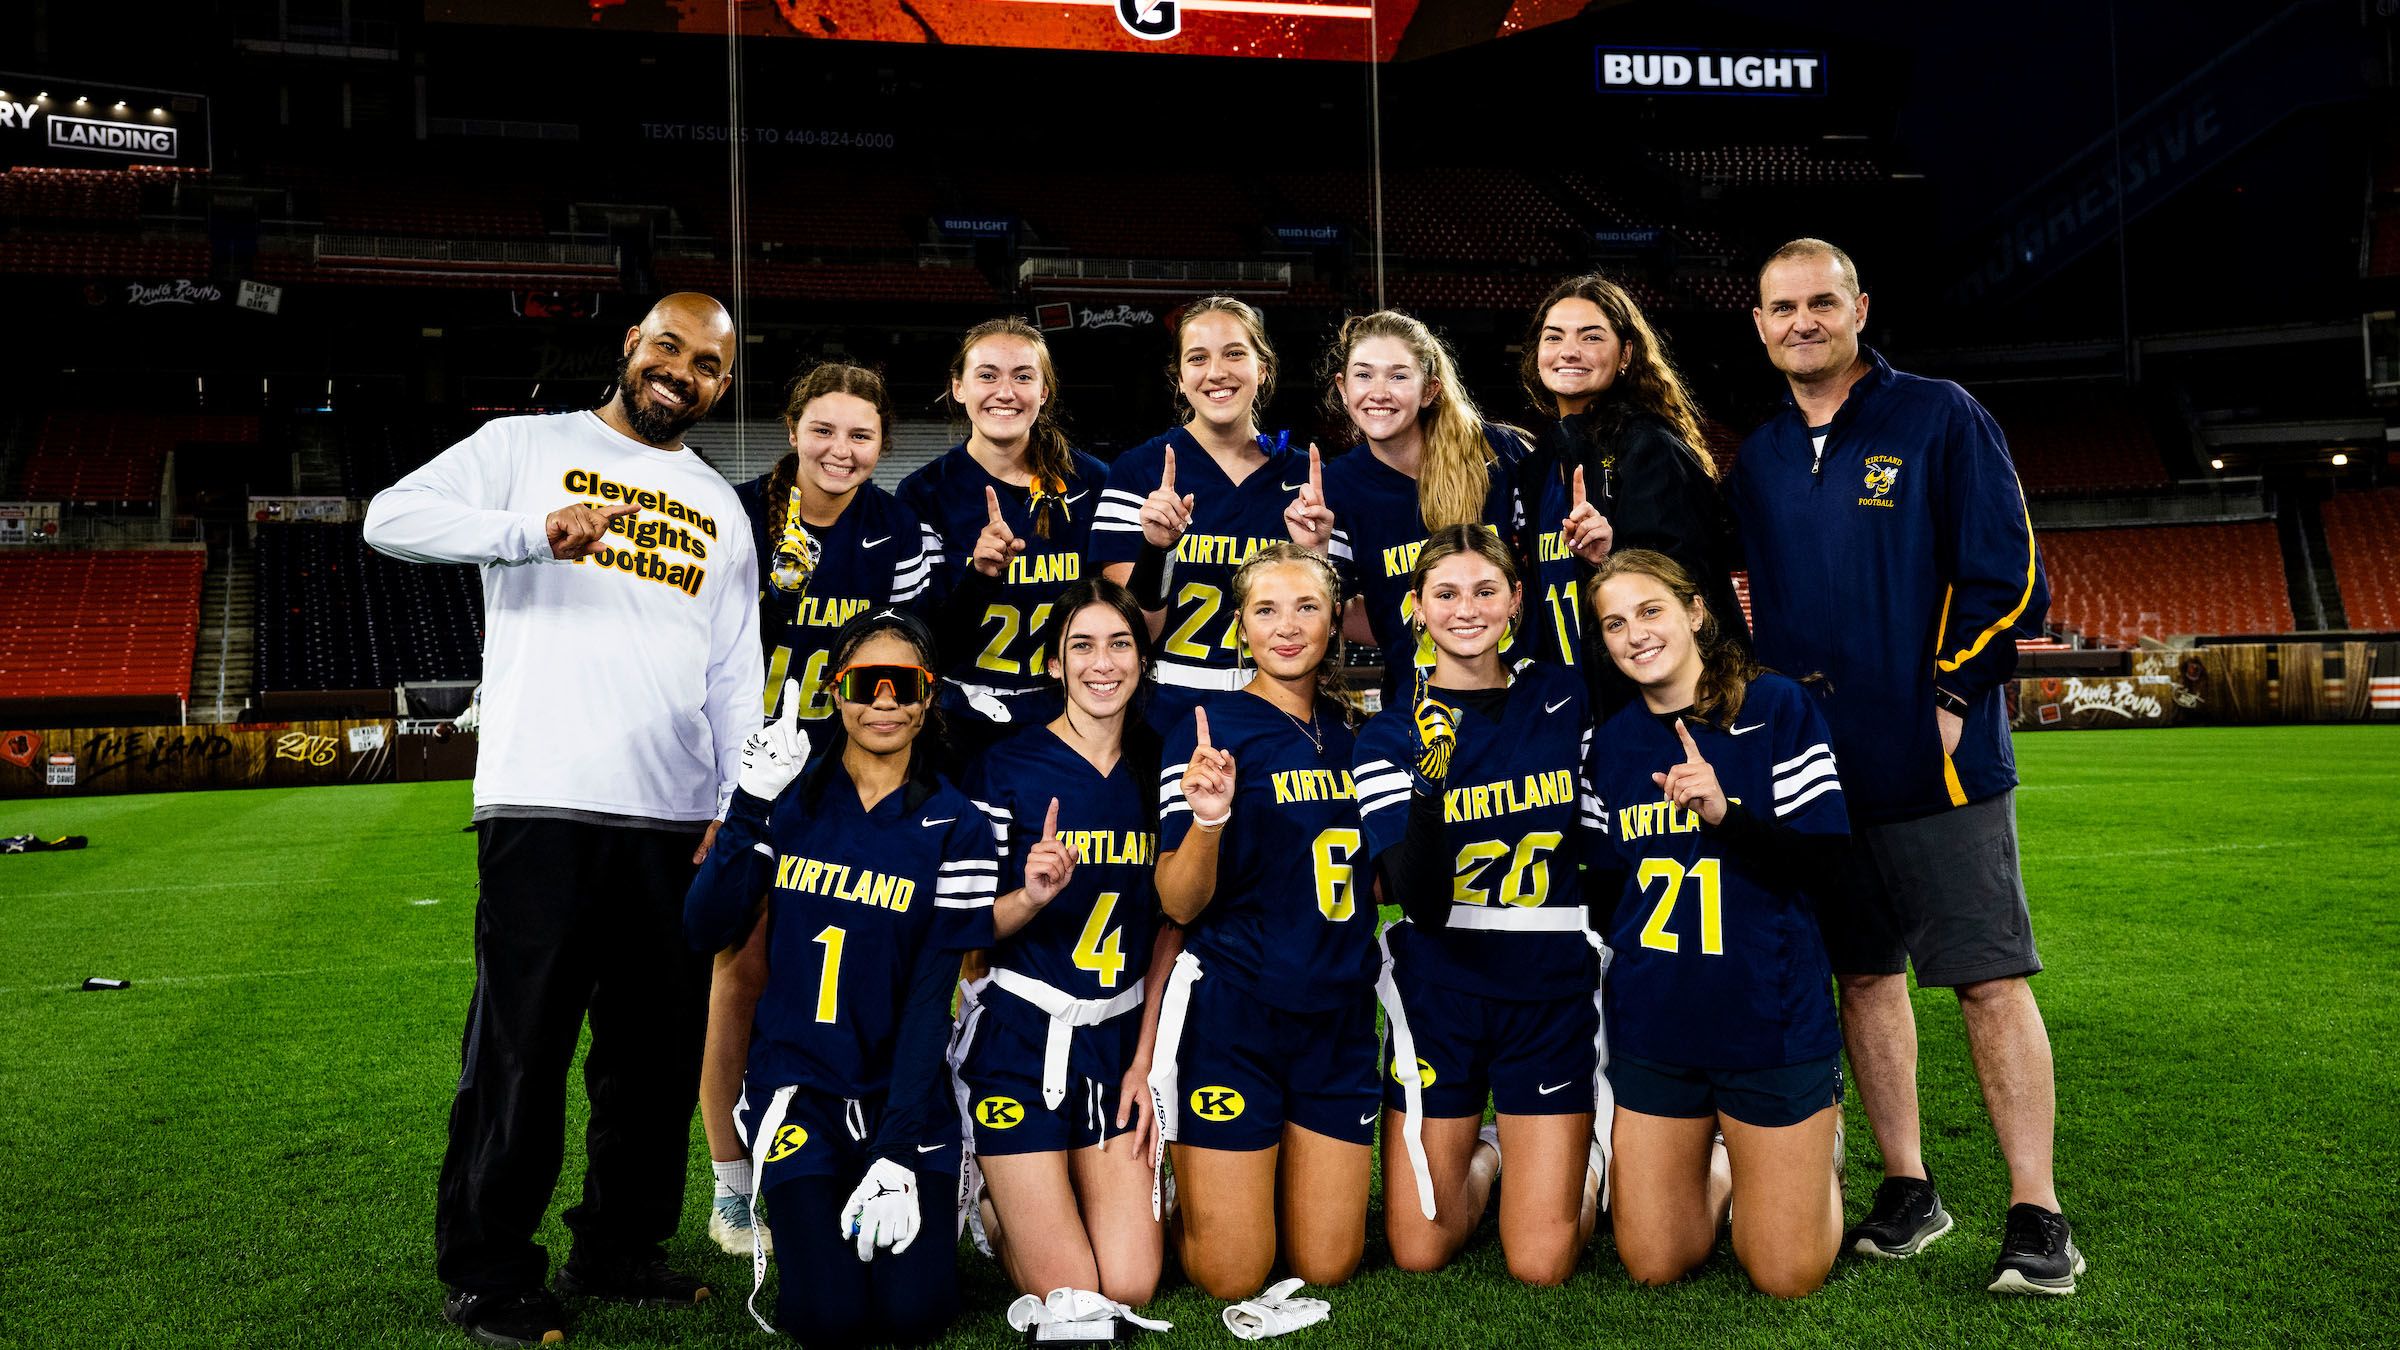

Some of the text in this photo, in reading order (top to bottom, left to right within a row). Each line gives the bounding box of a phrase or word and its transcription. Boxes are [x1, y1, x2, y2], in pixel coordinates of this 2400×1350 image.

[1603, 53, 1819, 89] BUD LIGHT
[55, 122, 170, 151] LANDING
[643, 122, 894, 149] TEXT ISSUS TO 440-824-6000
[944, 219, 1009, 232] BUD LIGHT
[1278, 227, 1303, 237] BUD
[1620, 231, 1653, 241] LIGHT
[127, 278, 222, 304] DAWG POUND
[1080, 305, 1154, 328] DAWG POUND
[1865, 455, 1903, 466] KIRTLAND
[563, 467, 717, 541] Cleveland
[1858, 498, 1894, 508] FOOTBALL
[581, 502, 707, 560] eights
[1175, 534, 1290, 565] KIRTLA
[573, 546, 705, 597] ootball
[966, 552, 1080, 584] TLAND
[1545, 580, 1581, 665] 11
[763, 645, 835, 719] 16
[2062, 677, 2112, 705] DAWG
[2112, 681, 2162, 718] POUND
[83, 732, 233, 772] THE LAND
[276, 731, 339, 767] 216
[1271, 769, 1358, 804] KIRTLA
[1443, 769, 1574, 823] KIRTLAND
[775, 854, 916, 913] KIRTLAND
[1312, 828, 1361, 921] 6
[1637, 857, 1723, 955] 21
[1072, 892, 1126, 988] 4
[812, 924, 847, 1024] 1
[985, 1101, 1018, 1123] K
[1198, 1091, 1236, 1116] K
[767, 1127, 799, 1160] K
[962, 1163, 970, 1198] USA
